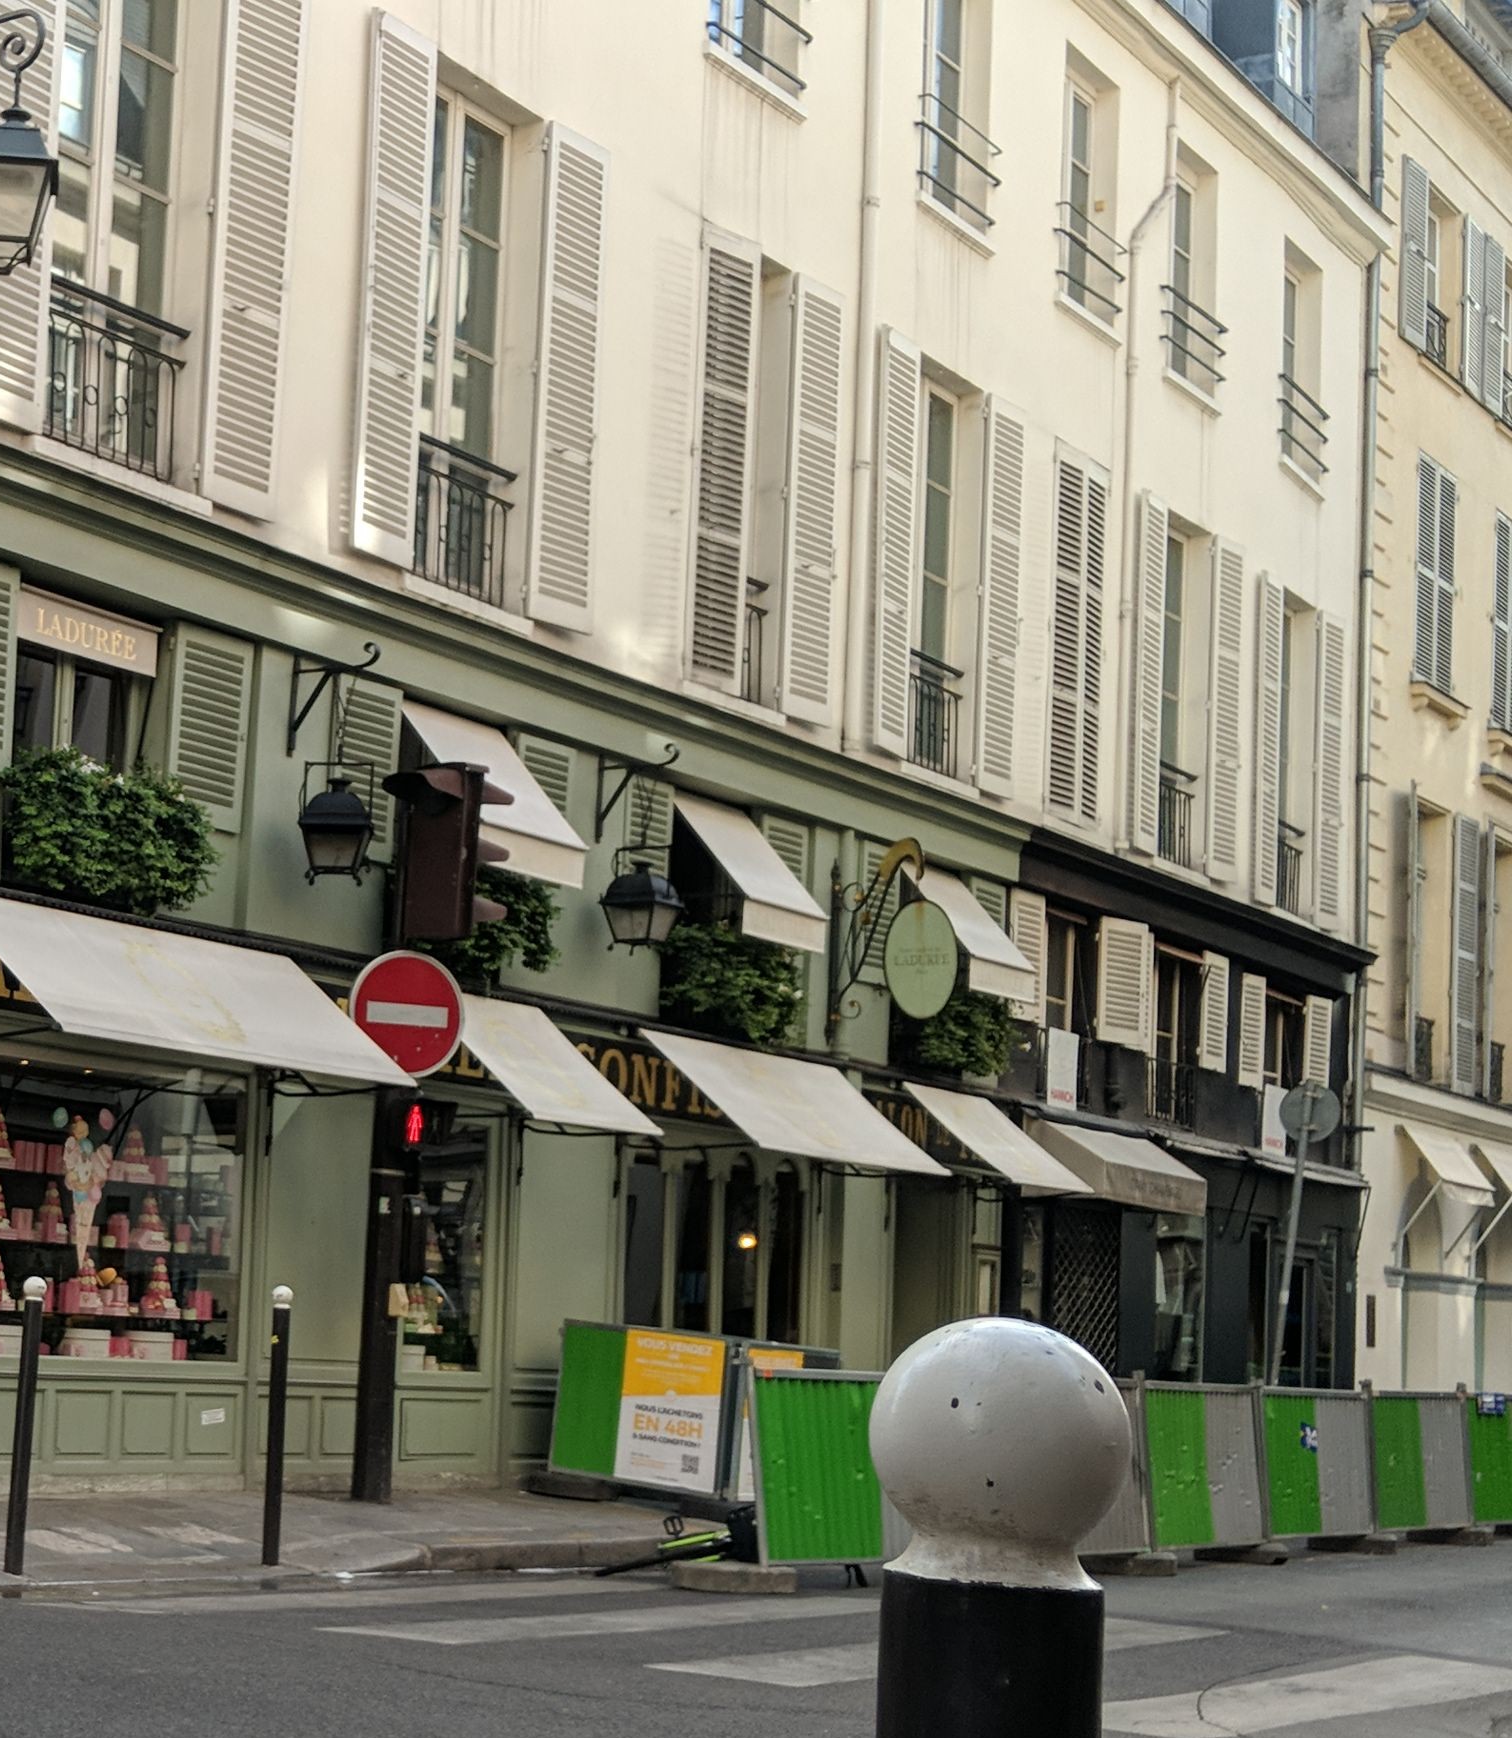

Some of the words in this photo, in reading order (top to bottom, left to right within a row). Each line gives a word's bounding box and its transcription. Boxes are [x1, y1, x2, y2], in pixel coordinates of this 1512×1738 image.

[37, 606, 138, 661] LADURÉE
[633, 1412, 659, 1432] EN
[664, 1418, 703, 1439] 48H
